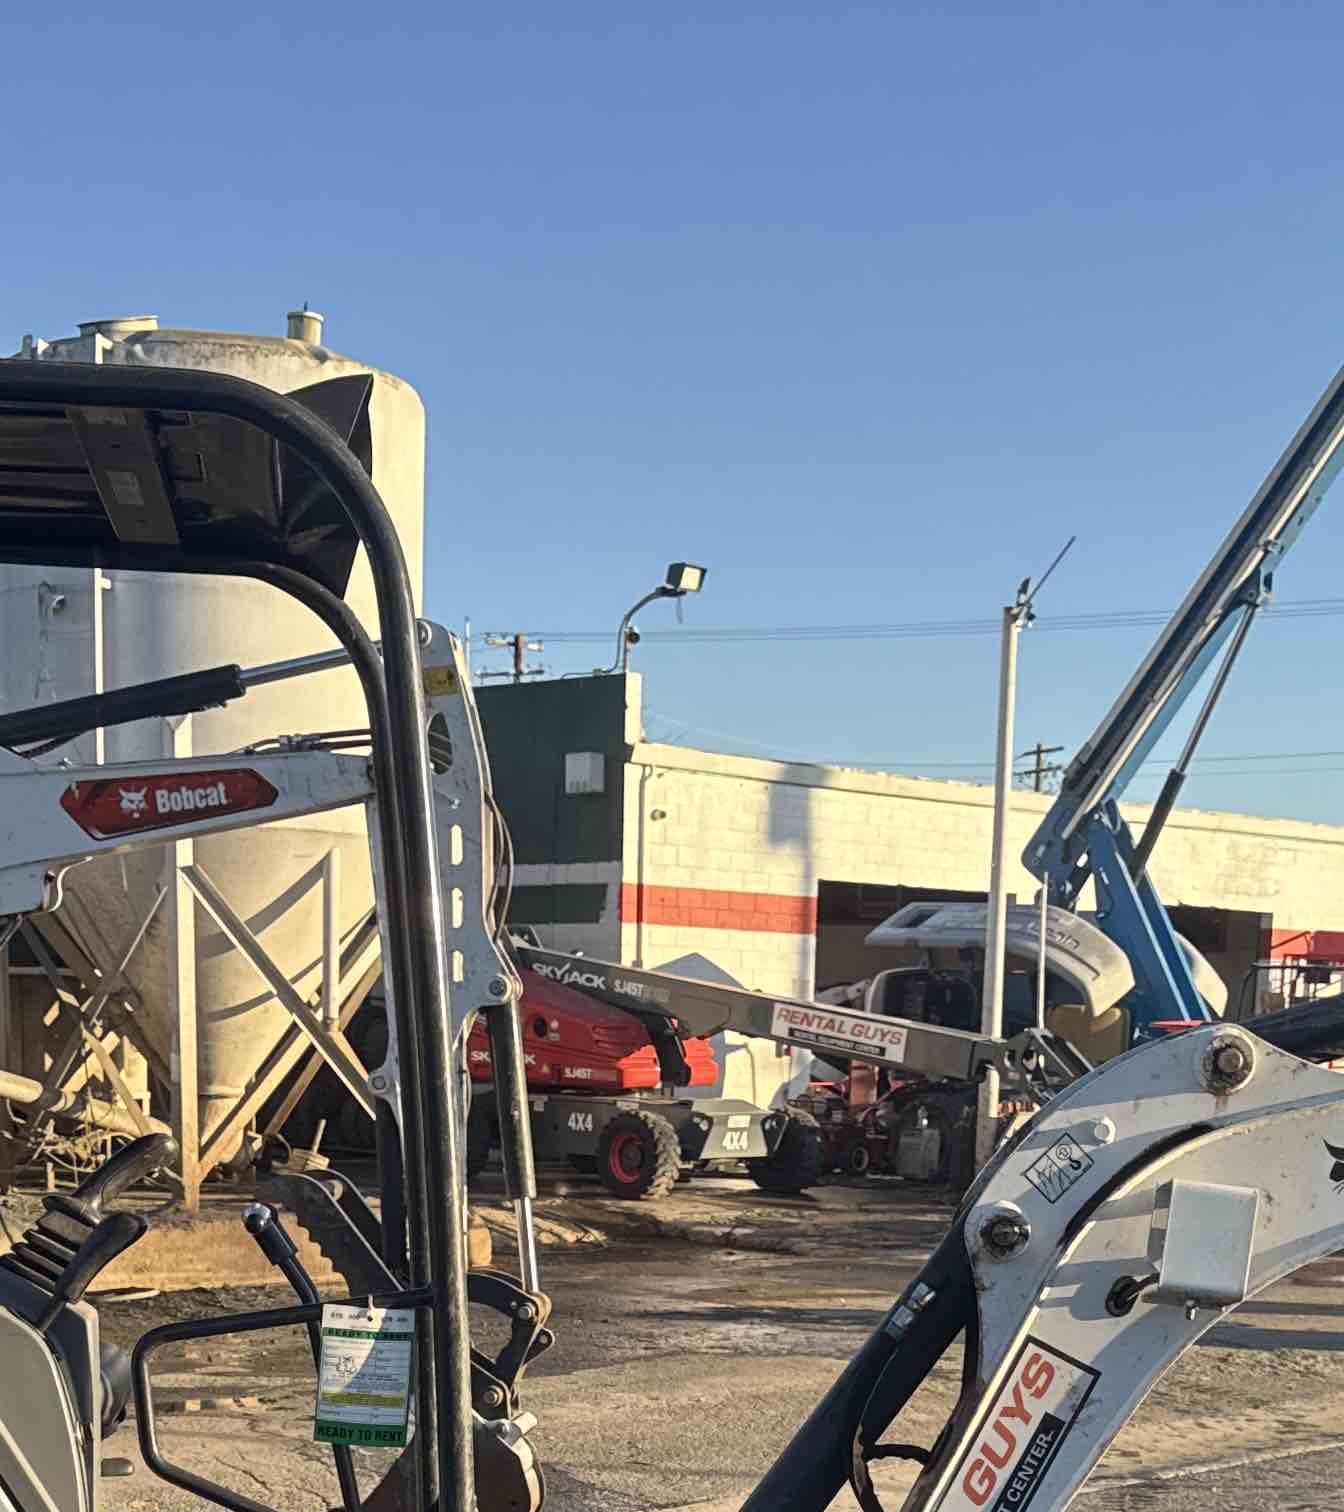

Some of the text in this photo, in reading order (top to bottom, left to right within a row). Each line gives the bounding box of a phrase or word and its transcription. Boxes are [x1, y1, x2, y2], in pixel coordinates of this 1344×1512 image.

[156, 782, 227, 813] Bobcat
[531, 962, 607, 991] SKYJACK
[776, 1007, 904, 1046] RENTAL GUYS
[567, 1112, 593, 1132] 4X4
[722, 1131, 749, 1150] 4X4
[317, 1425, 354, 1439] READY
[962, 1352, 1055, 1506] GUYS
[1007, 1432, 1052, 1503] CENTER
